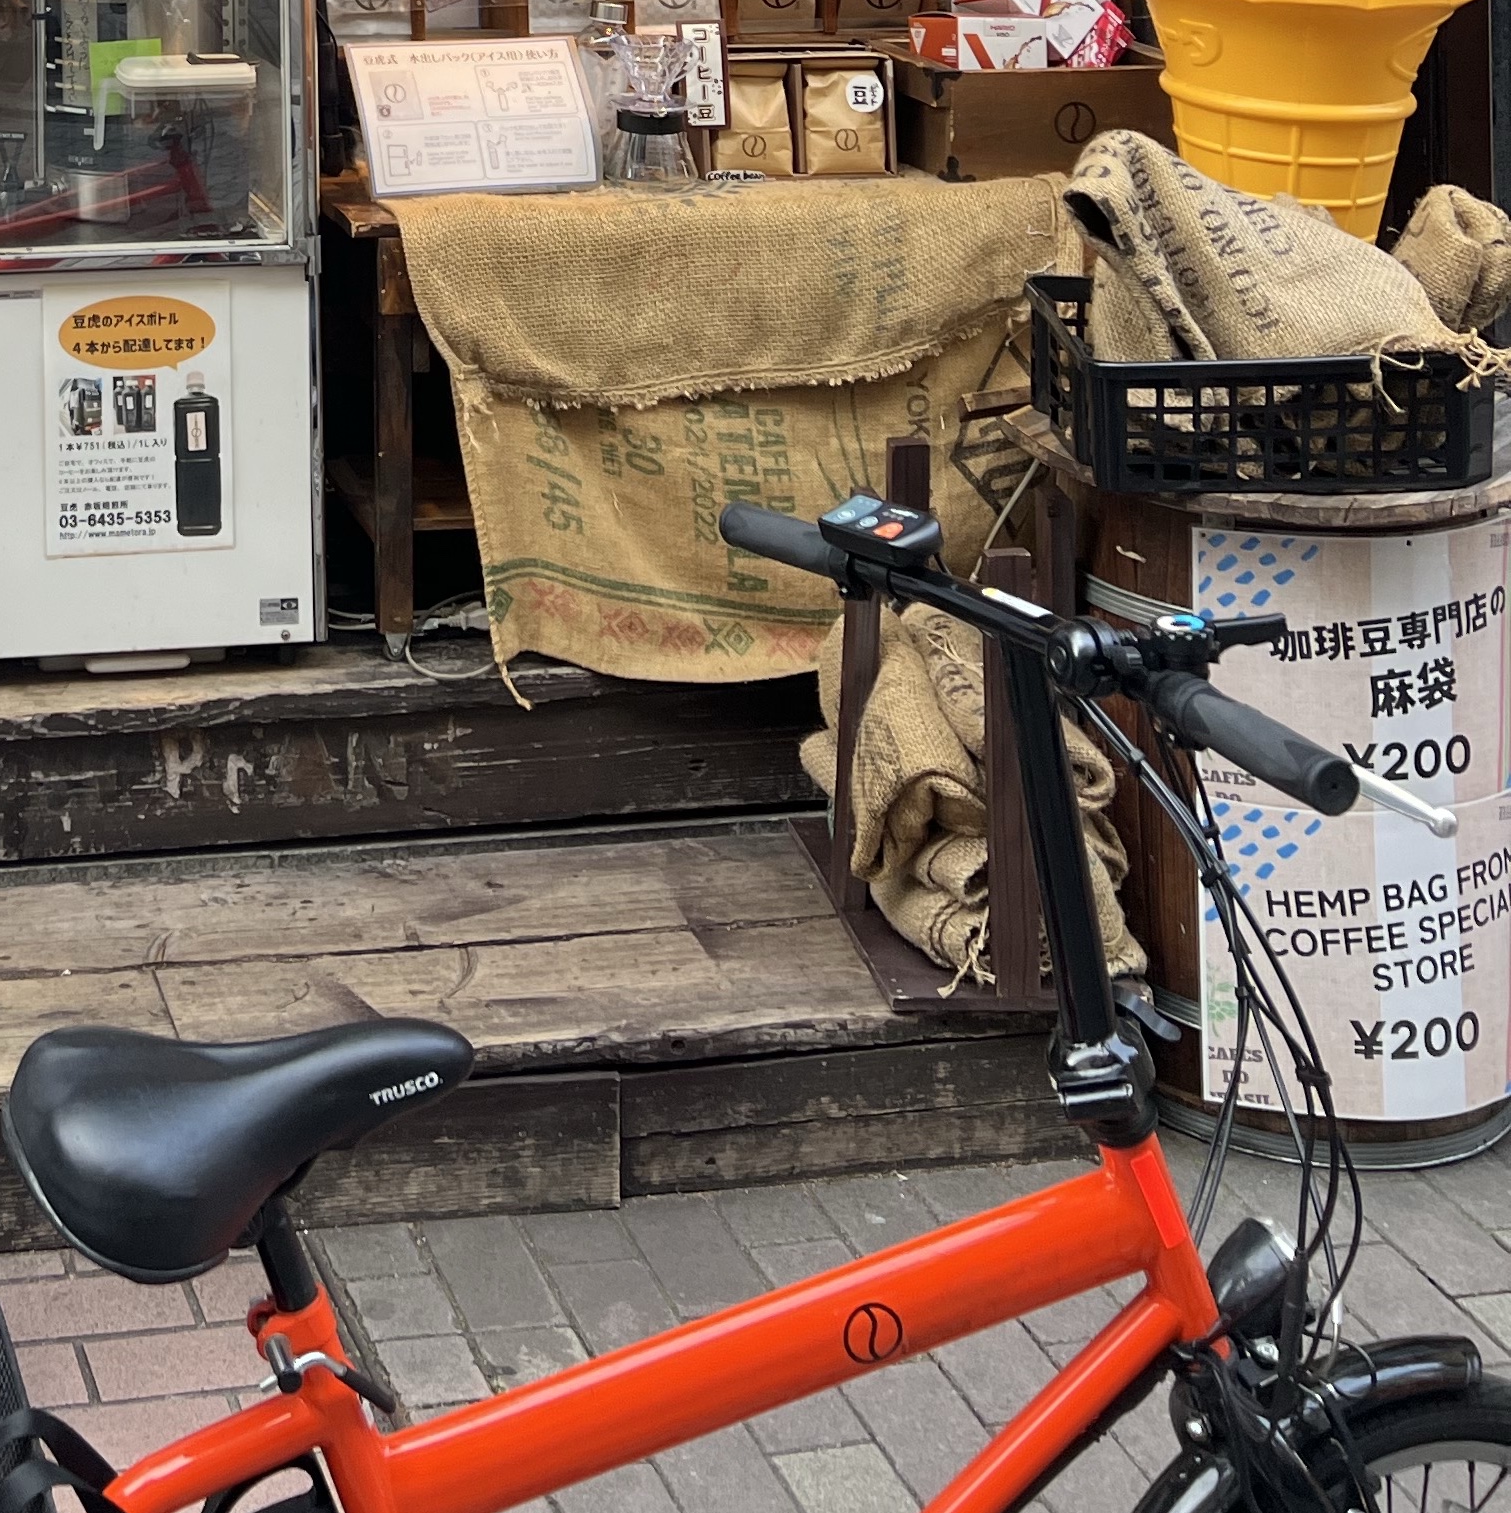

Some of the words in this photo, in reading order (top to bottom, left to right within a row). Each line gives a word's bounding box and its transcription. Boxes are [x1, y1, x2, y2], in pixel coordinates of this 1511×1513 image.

[691, 27, 717, 122] コーヒー豆
[707, 171, 741, 182] coffee
[72, 311, 179, 329] 豆虎のアイスボトル
[621, 426, 665, 477] 30
[753, 407, 798, 483] CAFÉ
[59, 510, 172, 529] 03-6435-5353
[1268, 584, 1506, 662] 珈琲豆専門店の
[1369, 655, 1458, 719] 麻袋
[1342, 734, 1472, 781] ¥200
[1265, 887, 1371, 918] HEMP
[1383, 873, 1449, 913] BAG
[1264, 921, 1408, 957] COFFEE
[1372, 942, 1475, 992] STORE
[1349, 1011, 1480, 1061] ¥200
[368, 1071, 445, 1107] TRUSCO
